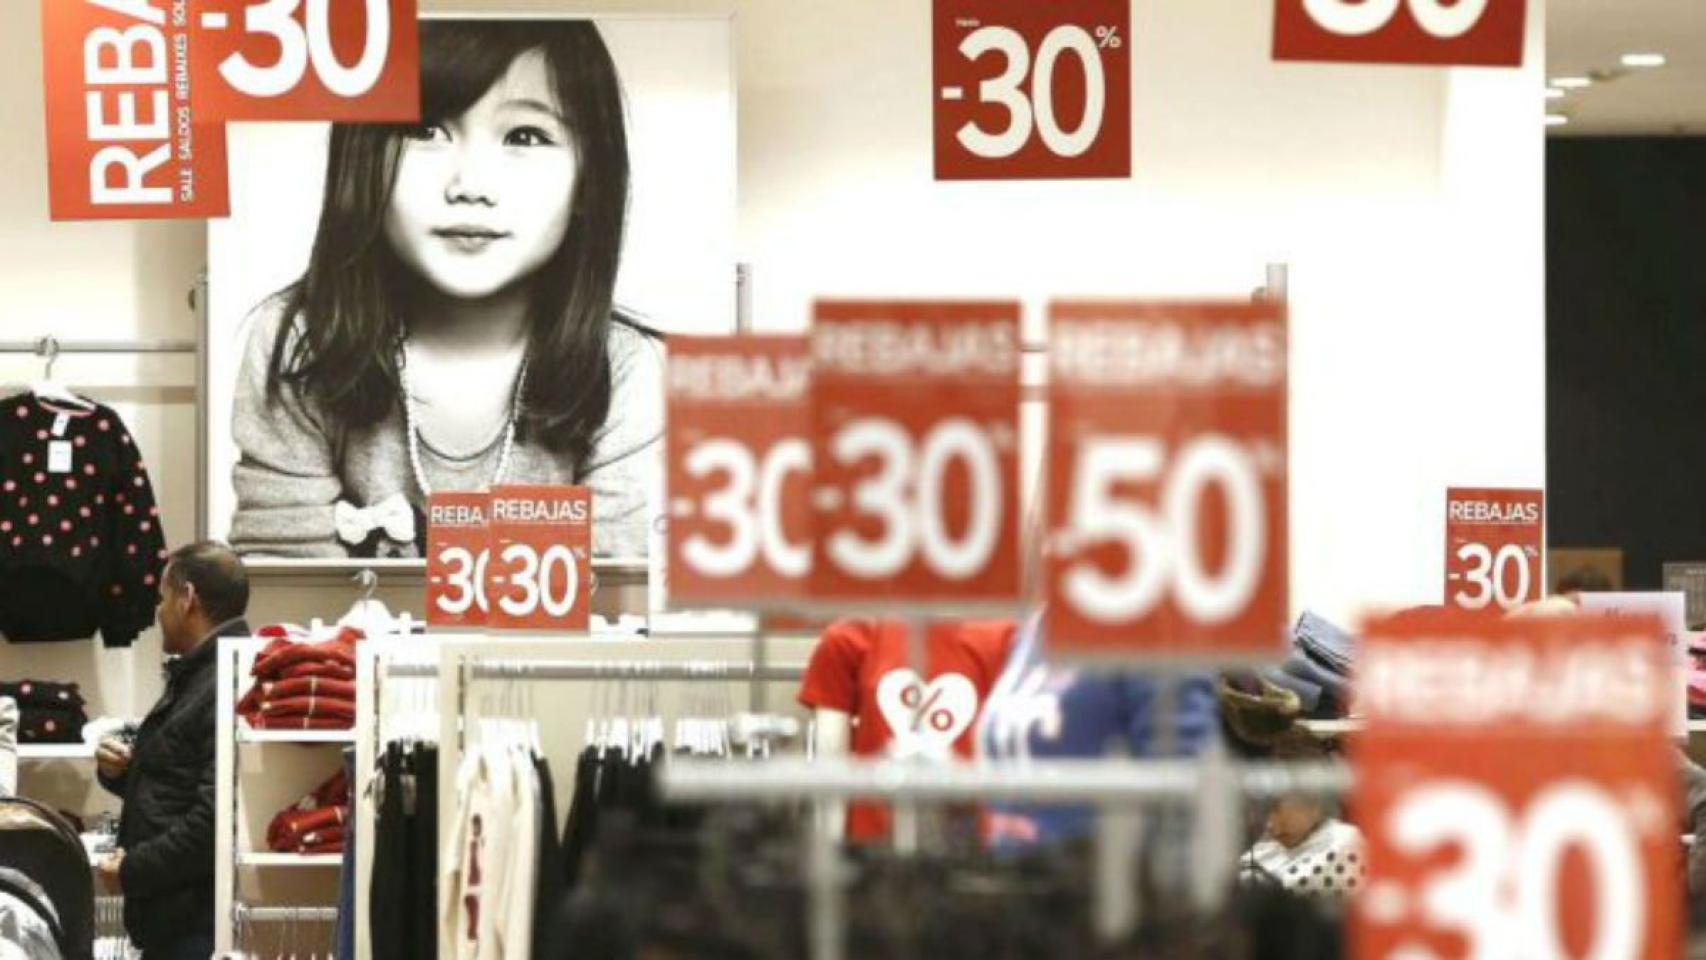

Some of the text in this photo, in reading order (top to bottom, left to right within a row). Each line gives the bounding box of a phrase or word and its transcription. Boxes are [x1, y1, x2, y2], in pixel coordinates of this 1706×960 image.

[177, 106, 192, 160] SALDOS
[180, 167, 193, 203] SALE
[493, 499, 588, 521] REBAJAS
[1449, 501, 1539, 521] REBAJAS
